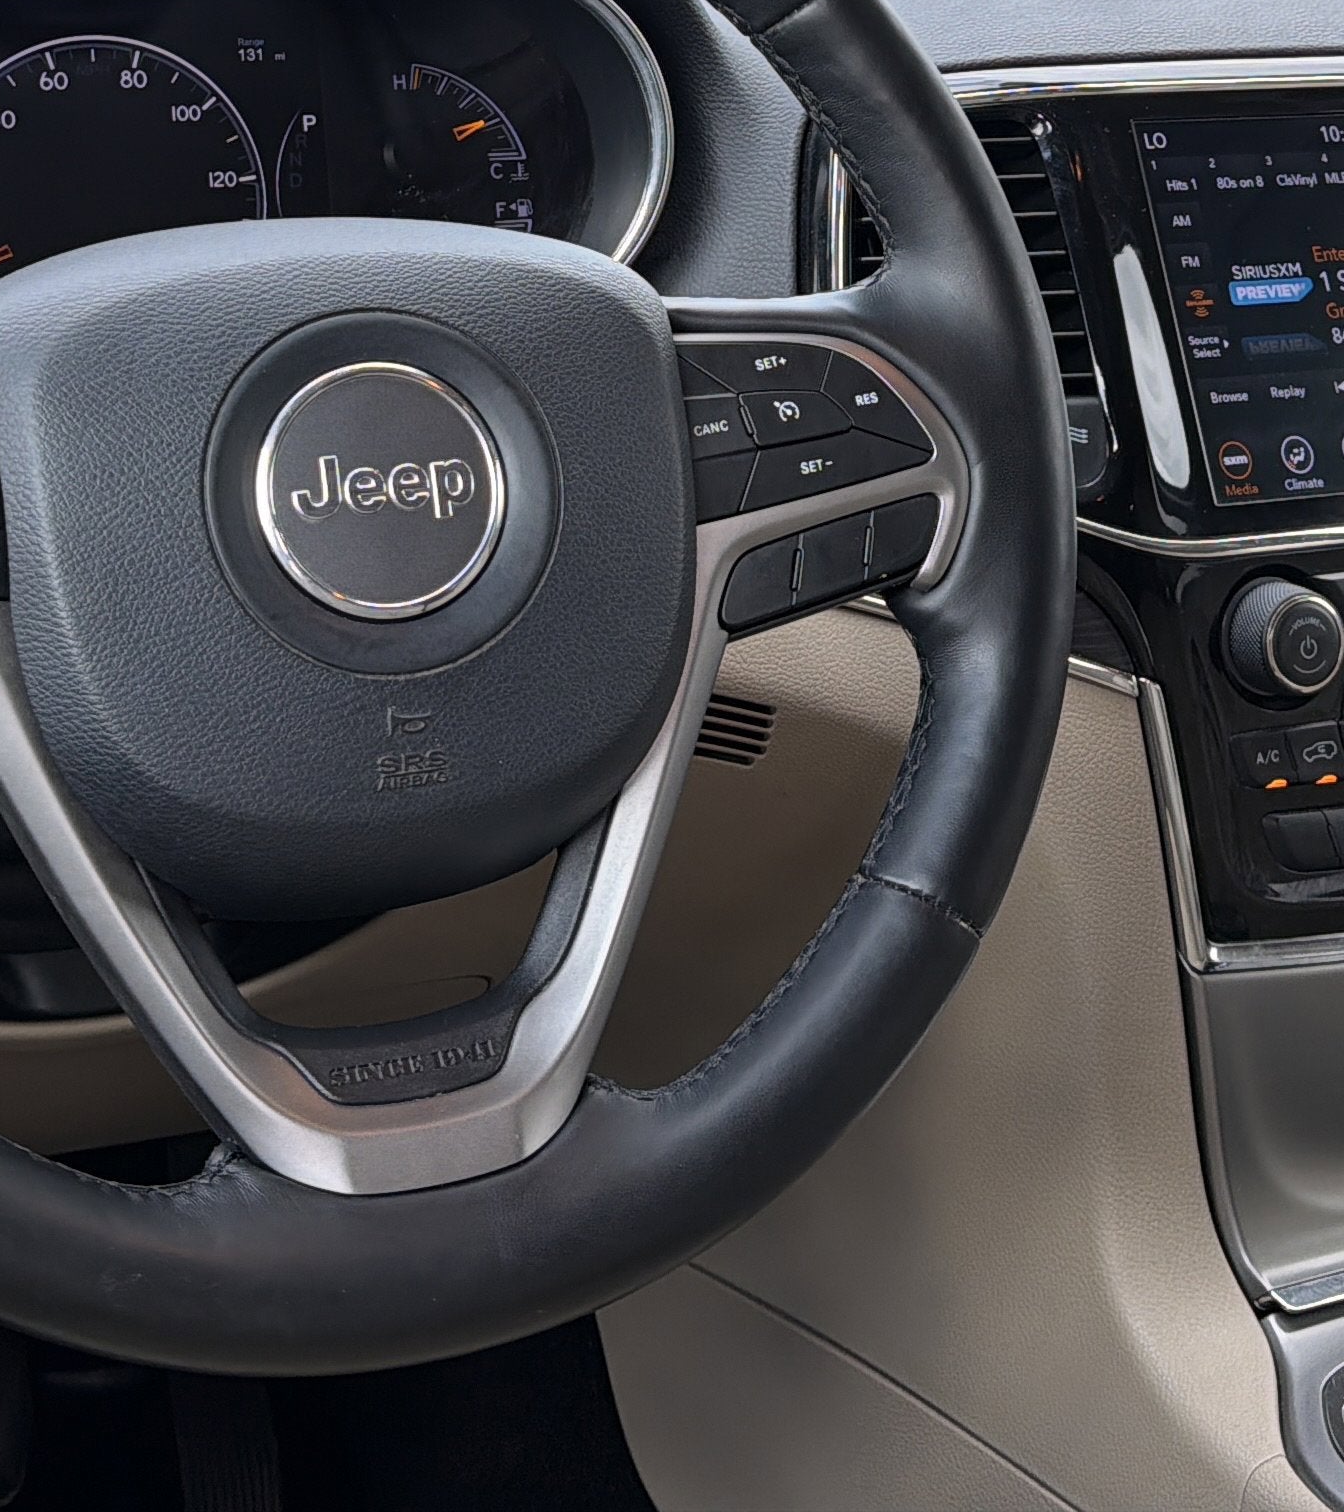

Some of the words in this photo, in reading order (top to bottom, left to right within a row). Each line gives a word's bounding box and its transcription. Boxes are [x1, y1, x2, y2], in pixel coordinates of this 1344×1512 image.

[237, 37, 265, 47] Range
[237, 48, 263, 62] 131
[39, 71, 69, 91] 60
[119, 69, 148, 89] 80
[392, 74, 407, 90] H
[171, 104, 202, 122] 100
[302, 114, 317, 132] P
[1143, 132, 1167, 150] LO
[1208, 157, 1216, 169] 2
[1264, 155, 1273, 166] 3
[1321, 153, 1329, 163] 4
[490, 163, 504, 180] C
[208, 171, 238, 188] 120
[1165, 179, 1189, 192] Hits
[1216, 177, 1237, 190] 80s
[1239, 178, 1254, 189] on
[1256, 175, 1265, 188] 8
[495, 201, 507, 218] F
[1172, 214, 1192, 228] AM
[1181, 255, 1201, 269] FM
[1231, 262, 1303, 280] SIRIUSXM
[1319, 270, 1331, 293] 1
[1234, 283, 1306, 300] PREVIEW
[1188, 336, 1220, 347] Source
[1193, 348, 1222, 359] Select
[754, 356, 788, 371] SET+
[855, 391, 879, 406] RES
[1210, 392, 1249, 404] Browse
[1270, 385, 1306, 400] Replay
[693, 419, 729, 437] CANC
[290, 454, 475, 522] Jeep
[1225, 484, 1259, 497] Media
[1284, 478, 1325, 491] Climate
[1291, 616, 1321, 629] VOLUME
[376, 748, 448, 774] SRS
[1256, 751, 1280, 765] A/C
[376, 772, 449, 791] AIRBAG
[327, 1054, 425, 1088] SINCE
